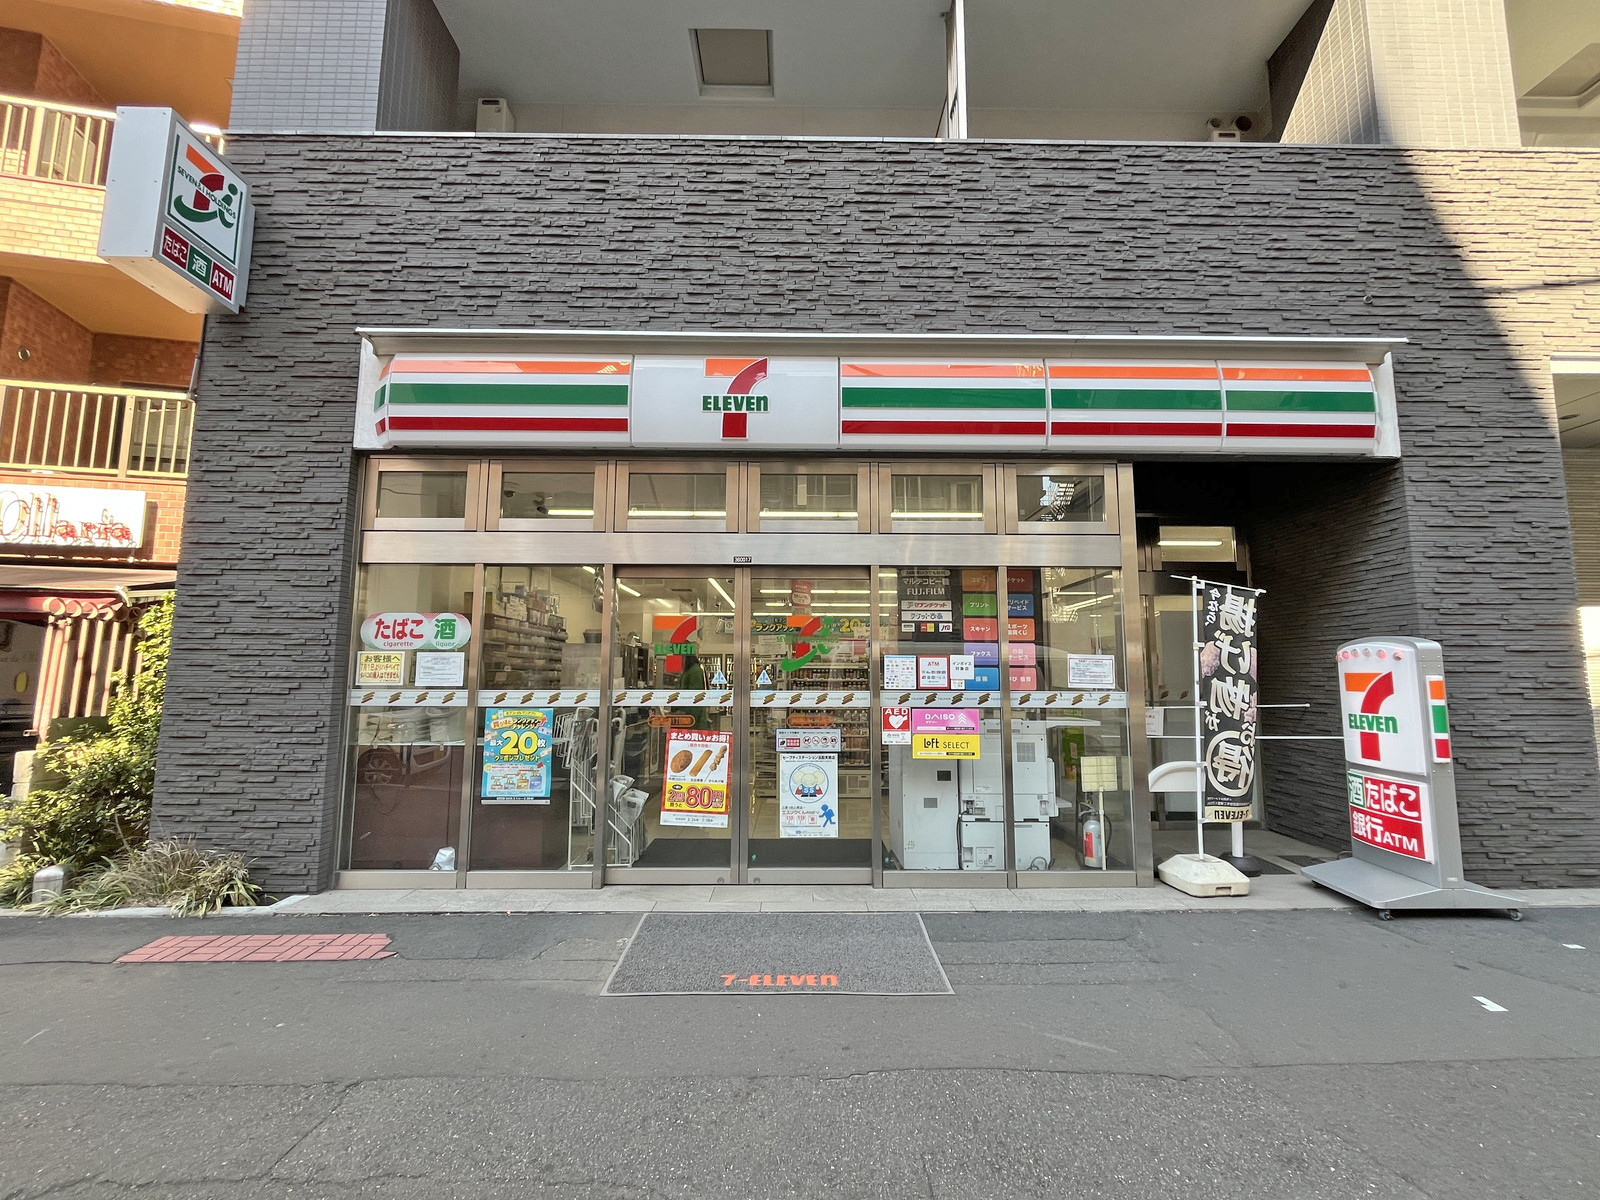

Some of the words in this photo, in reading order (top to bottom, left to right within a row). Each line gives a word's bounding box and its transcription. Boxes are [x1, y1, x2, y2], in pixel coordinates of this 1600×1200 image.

[177, 165, 197, 187] SEVEN
[205, 190, 237, 220] HOLDINGS
[164, 234, 187, 264] たばこ
[191, 253, 208, 278] 酒
[211, 271, 234, 295] ATM
[907, 587, 945, 595] FUJIFILM
[374, 618, 424, 640] たばこ
[434, 618, 457, 640] 酒
[839, 618, 862, 633] 20
[364, 655, 401, 663] お客様へ
[489, 739, 503, 747] 最大
[500, 730, 539, 755] 20
[670, 732, 730, 743] まとめ買いがお得!
[923, 738, 940, 749] Loft
[942, 741, 970, 749] SELECT
[685, 785, 713, 808] 80
[1348, 775, 1365, 806] 酒
[1365, 778, 1420, 818] たばこ
